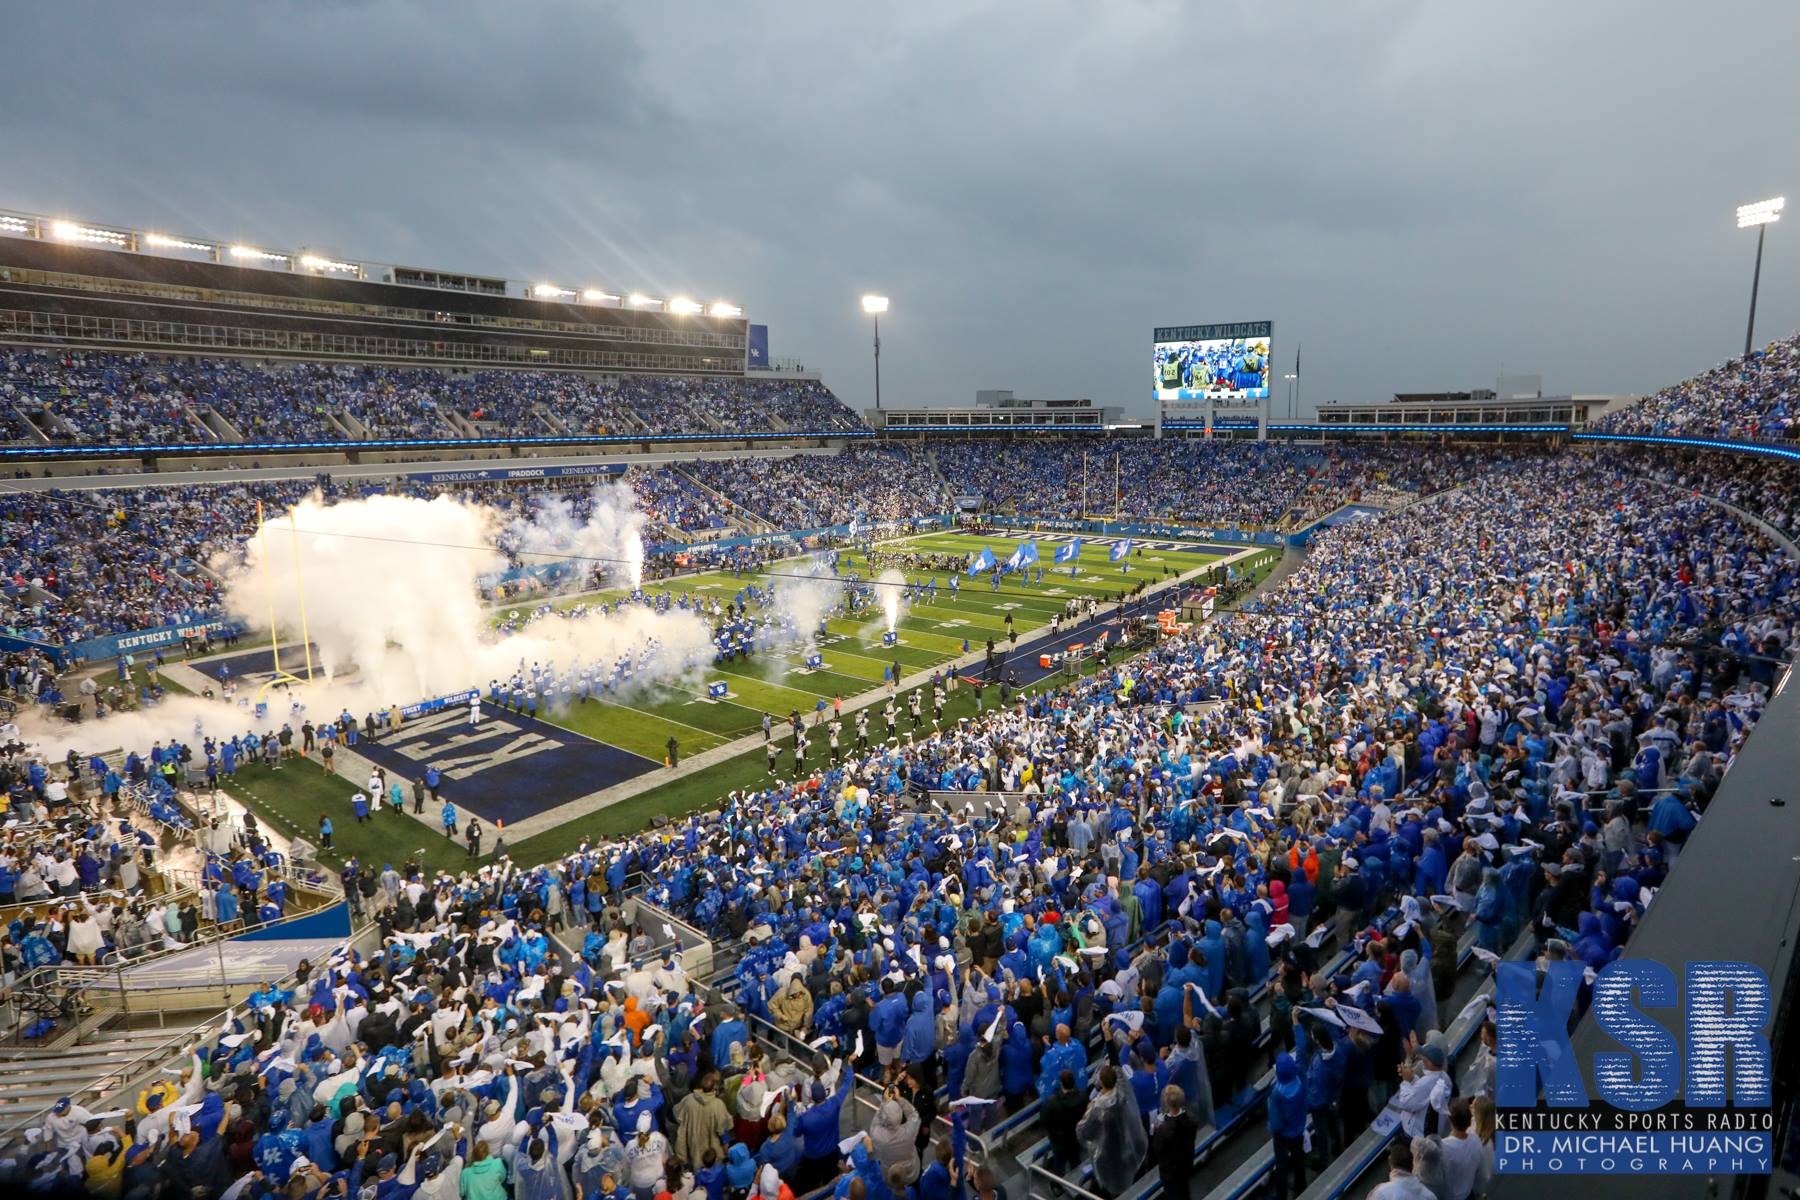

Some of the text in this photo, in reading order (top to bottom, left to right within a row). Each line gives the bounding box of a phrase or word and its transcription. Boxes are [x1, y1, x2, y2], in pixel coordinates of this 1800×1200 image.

[1157, 323, 1268, 341] KENTUCKY WILDCATS
[512, 469, 545, 478] PADDOCK
[561, 465, 598, 475] KEENELAND
[432, 473, 476, 482] KEENELAND
[118, 631, 173, 648] KENTUCKY
